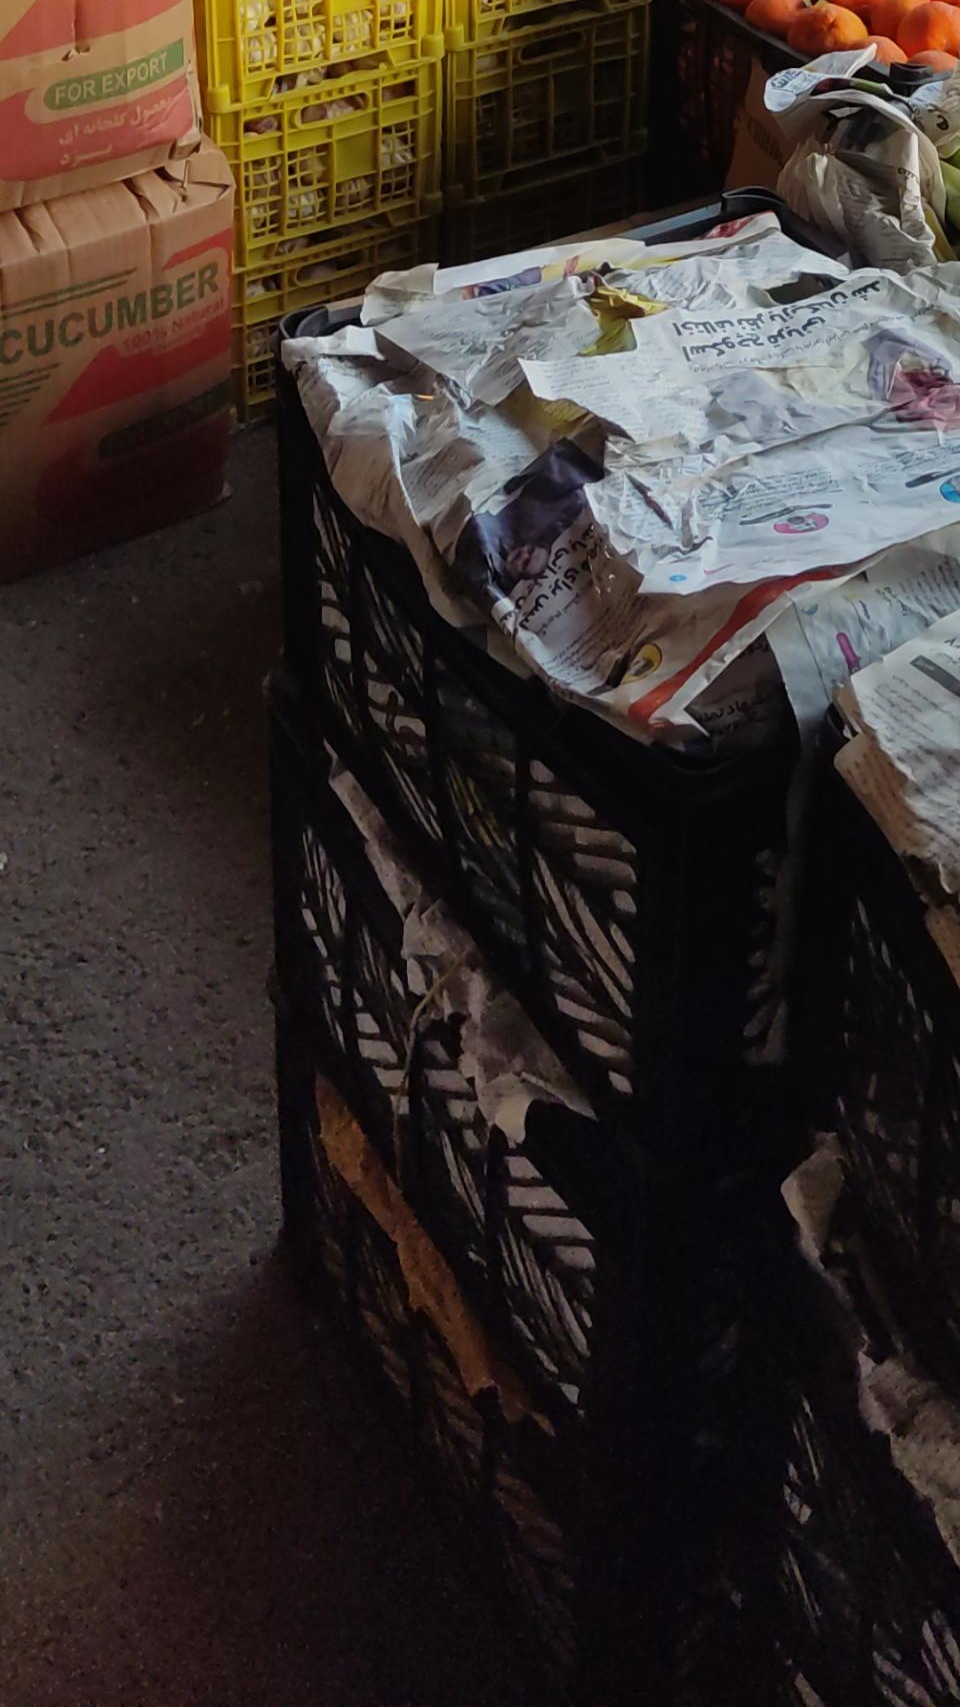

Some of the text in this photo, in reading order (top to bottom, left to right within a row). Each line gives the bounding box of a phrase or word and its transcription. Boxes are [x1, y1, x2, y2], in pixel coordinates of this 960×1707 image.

[55, 52, 168, 104] FOR EXPORT
[0, 262, 218, 365] CUCUMBER
[672, 320, 734, 336] اختلاف
[738, 314, 765, 332] نظر
[851, 281, 880, 302] شد
